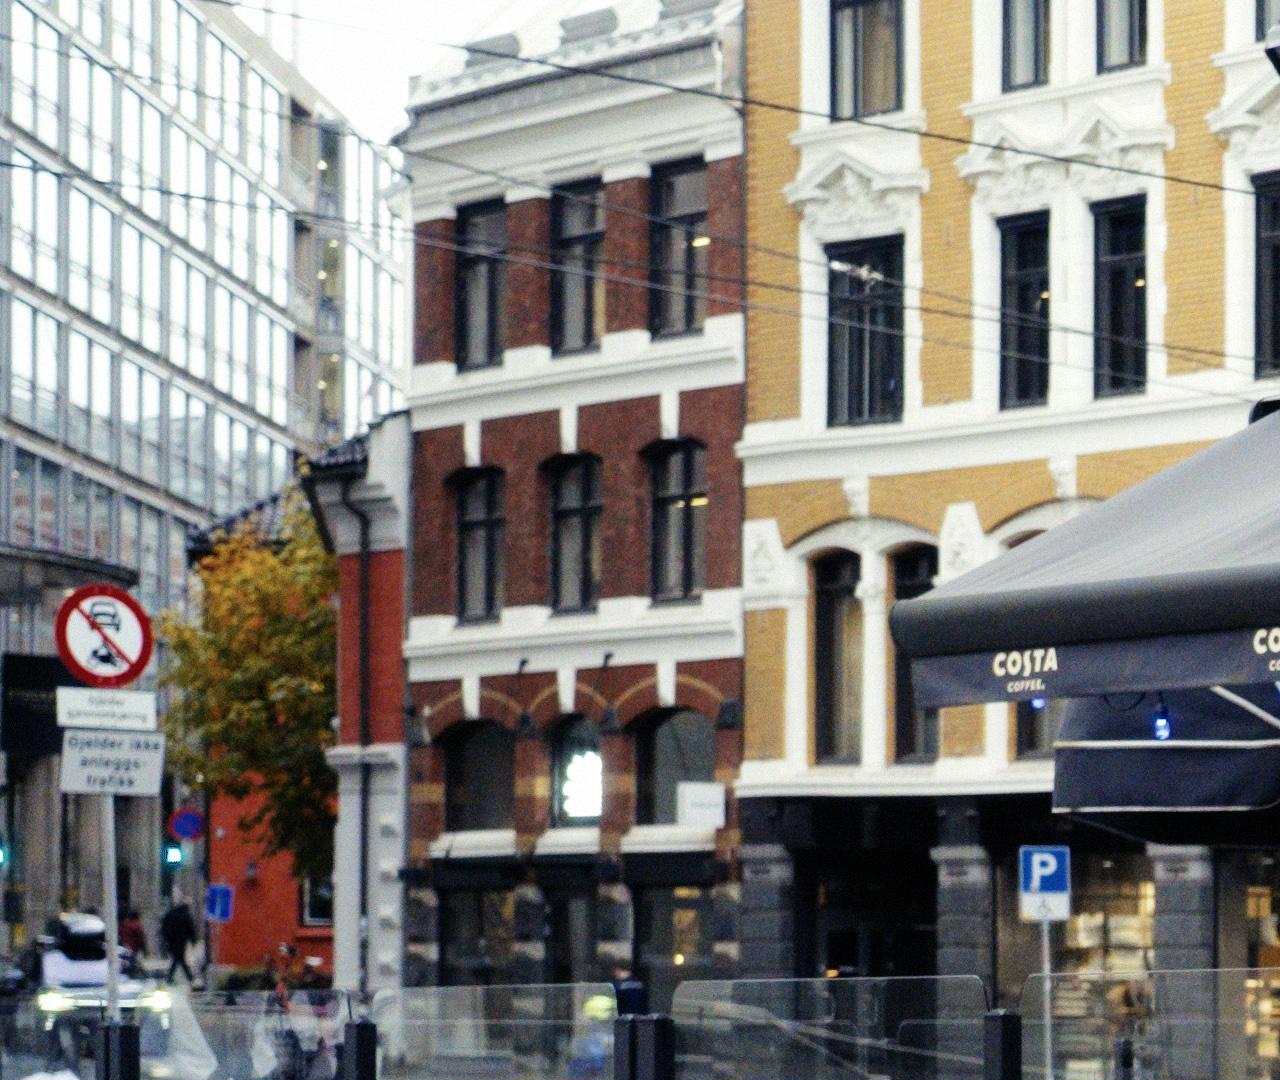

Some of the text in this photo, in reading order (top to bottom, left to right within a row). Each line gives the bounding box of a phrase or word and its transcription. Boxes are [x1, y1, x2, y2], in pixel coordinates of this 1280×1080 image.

[993, 648, 1058, 677] COSTA
[68, 737, 160, 752] Gjelder ikke
[86, 775, 135, 786] trafikk
[1031, 853, 1058, 893] P
